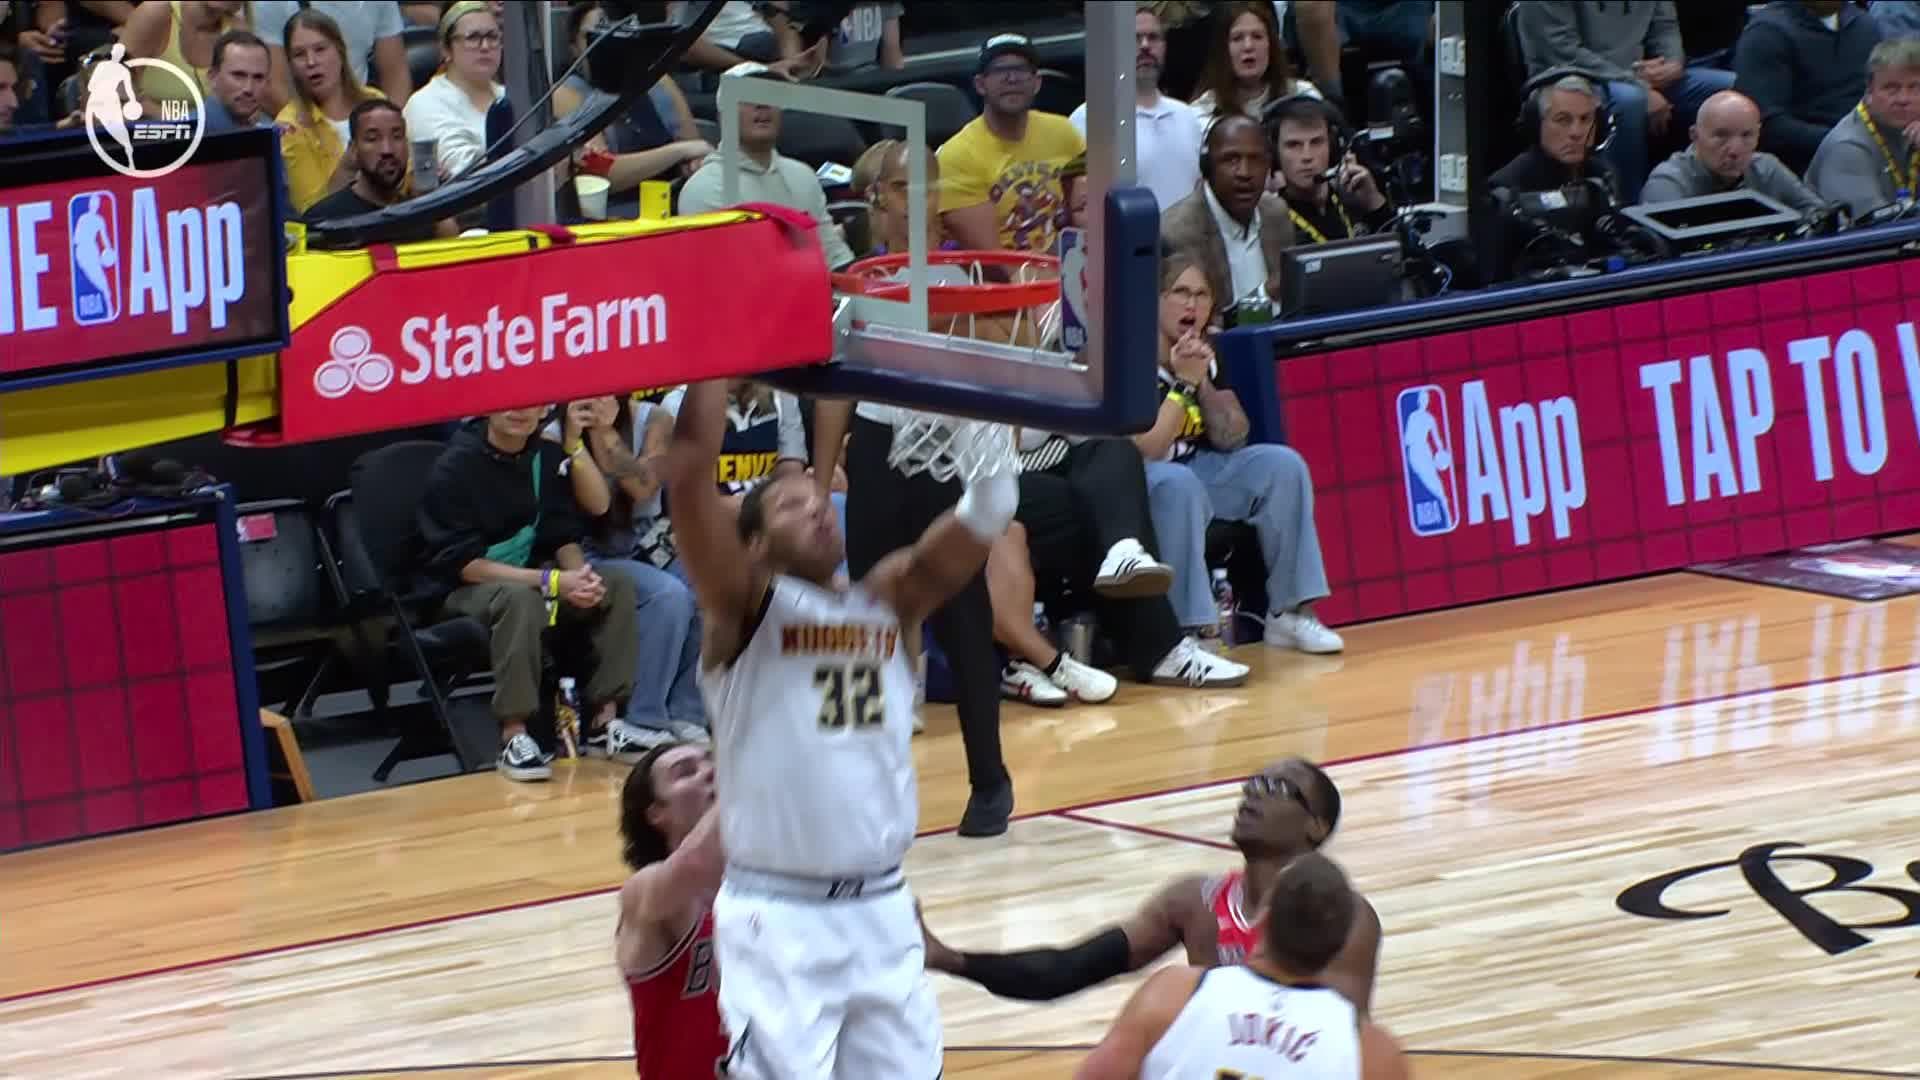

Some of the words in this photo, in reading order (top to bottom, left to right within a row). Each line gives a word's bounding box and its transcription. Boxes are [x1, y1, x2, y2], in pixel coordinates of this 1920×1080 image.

[129, 186, 246, 335] App
[717, 452, 779, 484] ENVE
[1462, 379, 1587, 547] App
[1639, 347, 1776, 507] TAP
[1787, 328, 1889, 482] TO
[813, 664, 884, 732] 32
